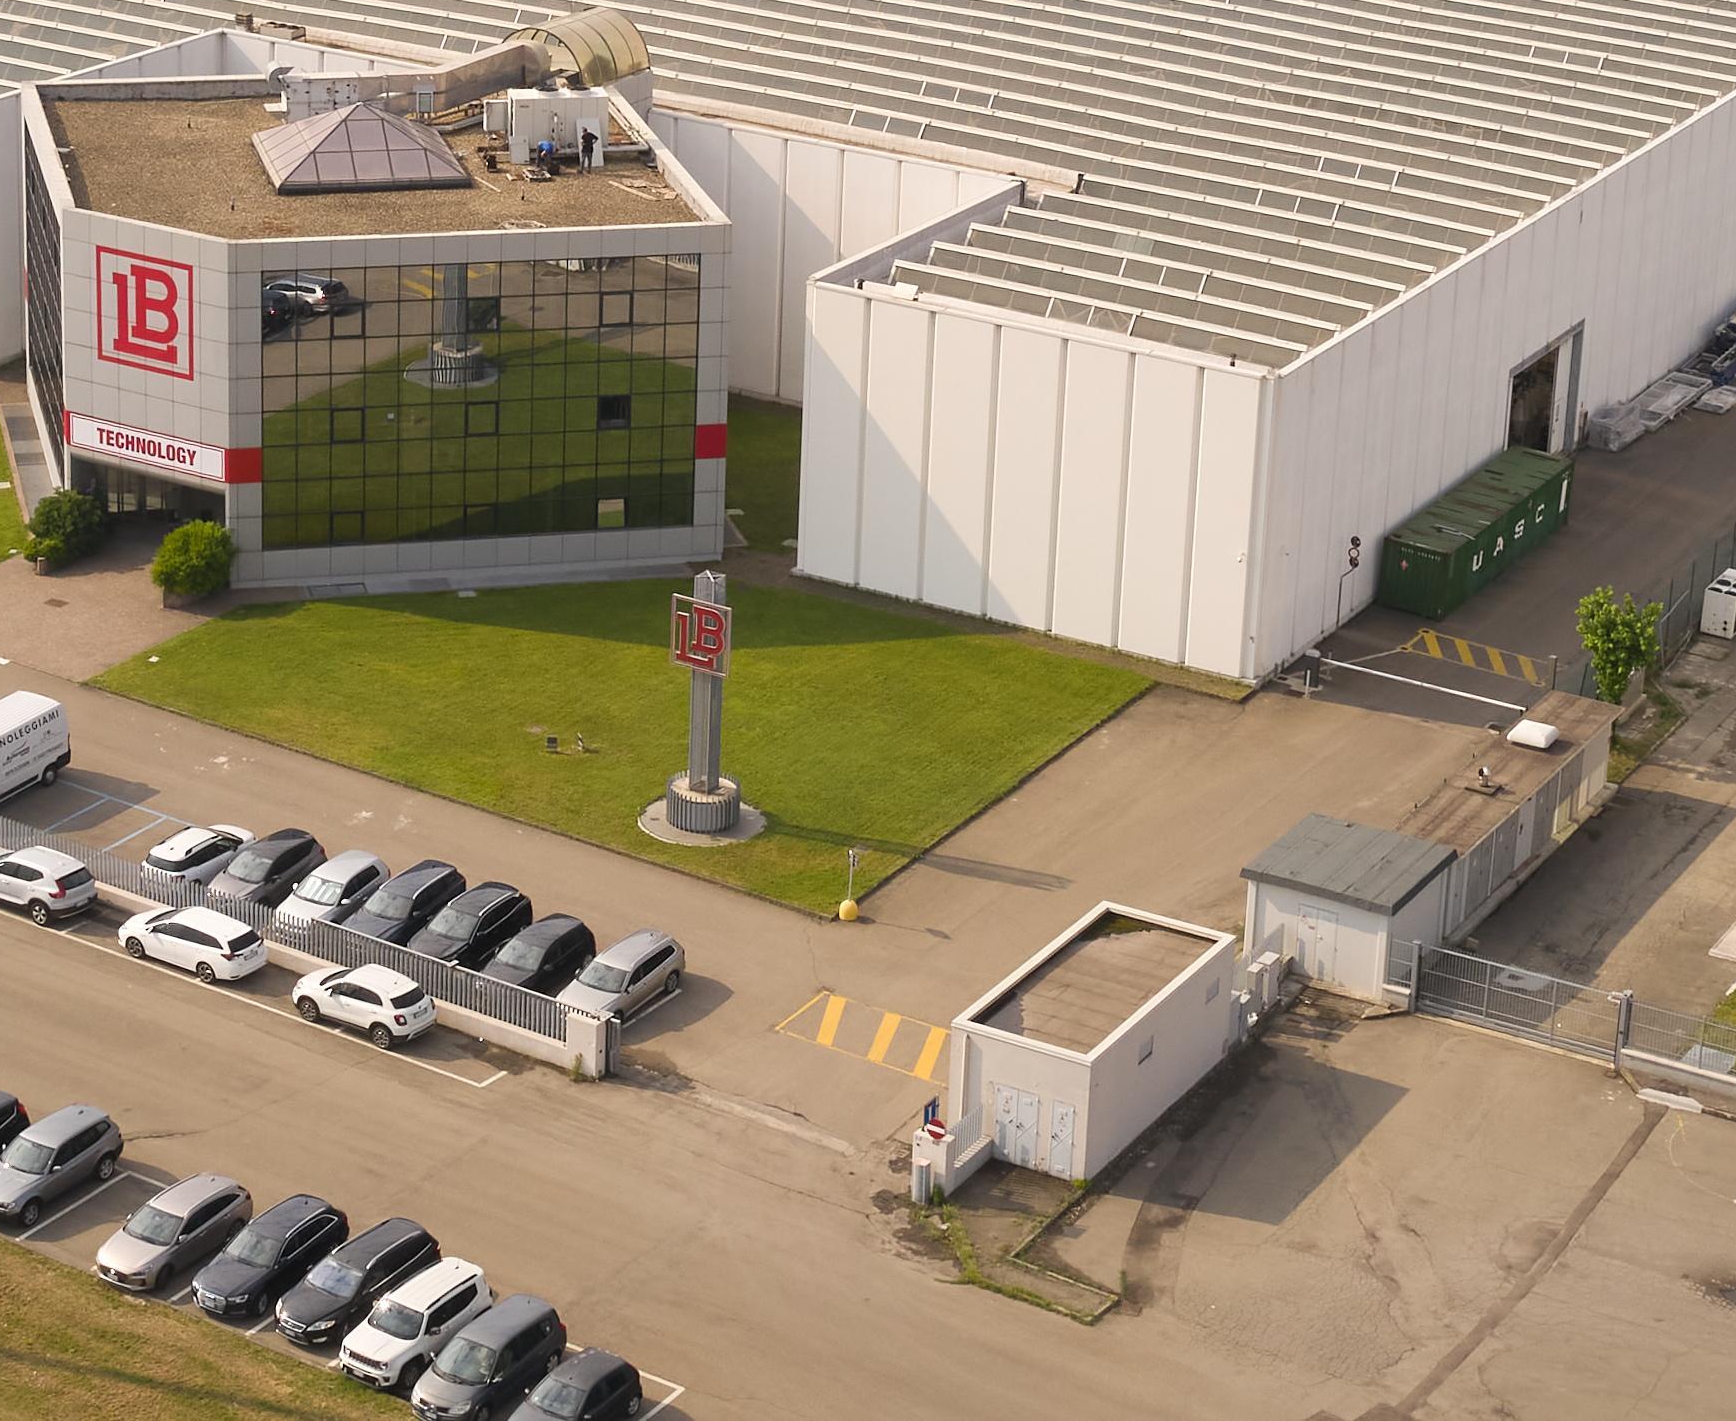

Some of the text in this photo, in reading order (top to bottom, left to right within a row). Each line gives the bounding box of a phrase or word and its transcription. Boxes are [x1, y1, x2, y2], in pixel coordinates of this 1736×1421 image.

[112, 263, 179, 364] LB
[96, 427, 197, 466] TECHNOLOGY
[675, 604, 726, 669] LB
[0, 709, 59, 748] NOLEGGIAMI
